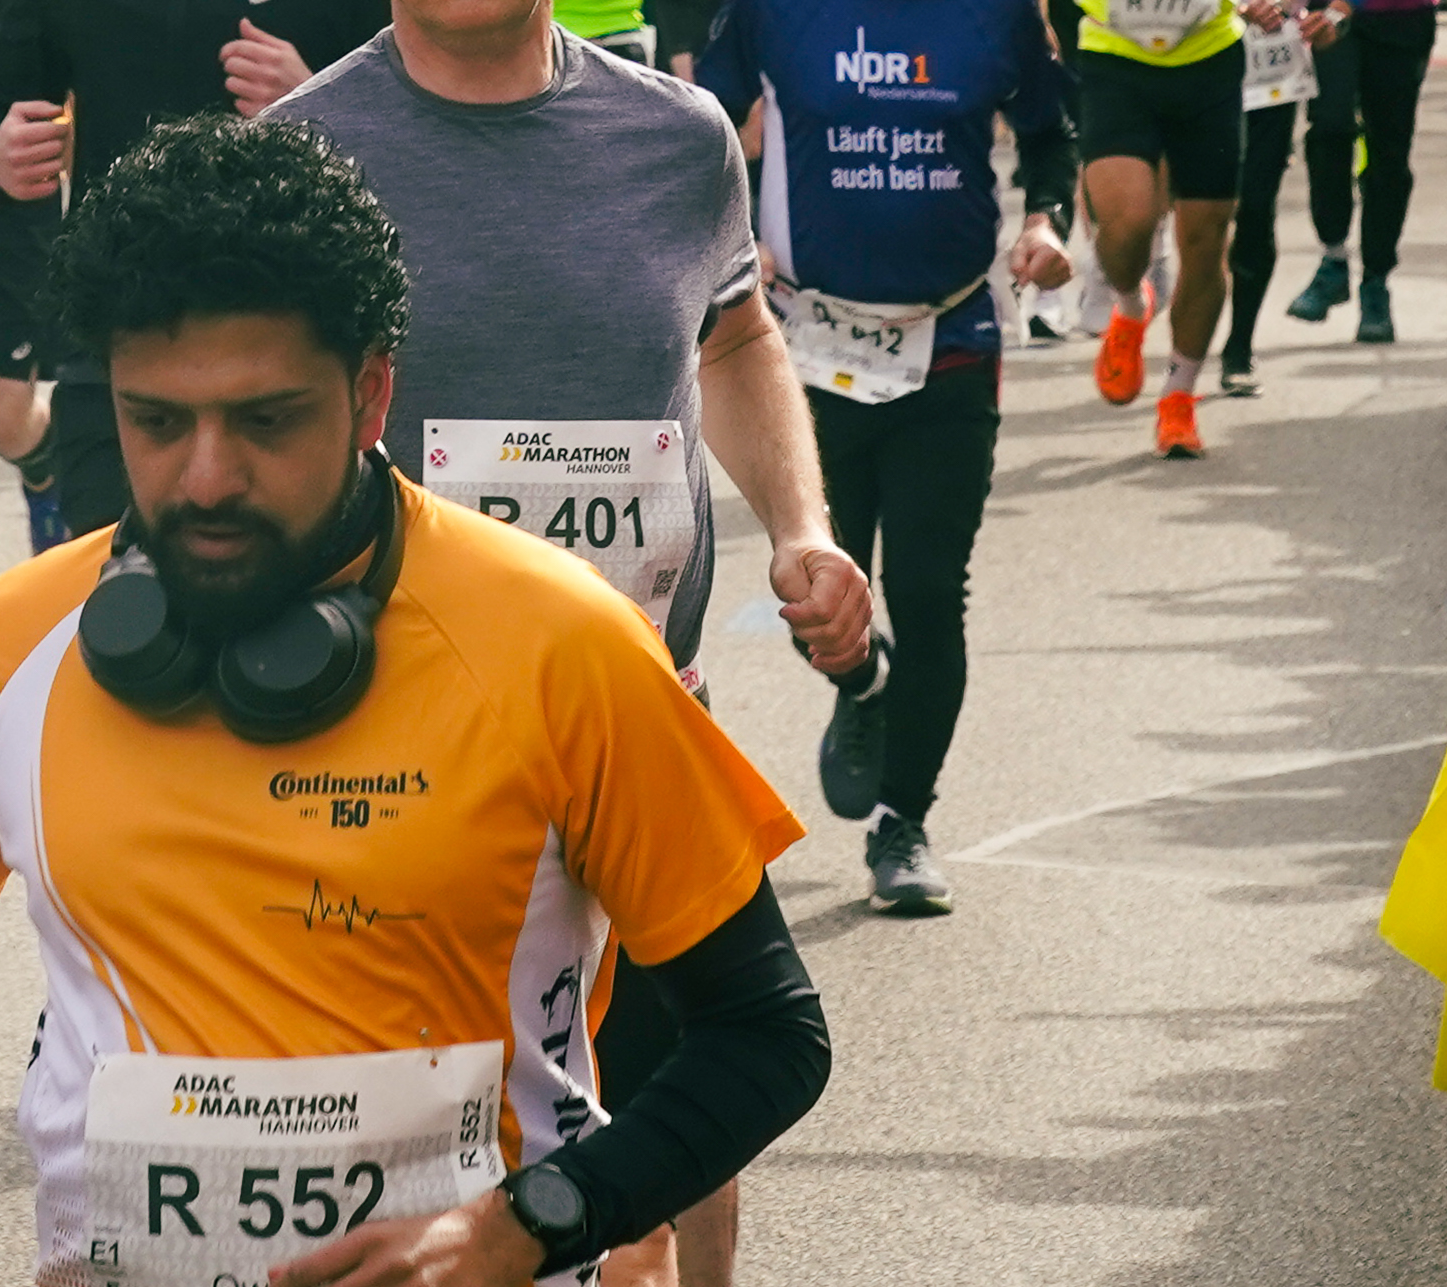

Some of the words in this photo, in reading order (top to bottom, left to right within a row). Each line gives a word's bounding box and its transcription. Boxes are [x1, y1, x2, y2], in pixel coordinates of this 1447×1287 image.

[835, 39, 909, 89] NDR
[914, 55, 930, 83] 1
[827, 126, 887, 153] Läuft
[890, 128, 945, 161] jetzt
[832, 165, 884, 190] auch
[890, 165, 925, 191] bei
[502, 433, 553, 446] ADAC
[523, 447, 631, 462] MARATHON
[566, 463, 632, 474] HANNOVER
[545, 496, 645, 549] 401
[269, 769, 408, 802] Continental
[330, 798, 371, 828] 150
[173, 1074, 236, 1094] ADAC
[199, 1093, 358, 1119] MARATHON
[258, 1116, 360, 1136] HANNOVER
[460, 1097, 483, 1144] 552
[459, 1148, 481, 1171] R
[147, 1162, 206, 1238] R
[238, 1160, 385, 1240] 552
[90, 1238, 119, 1267] E1
